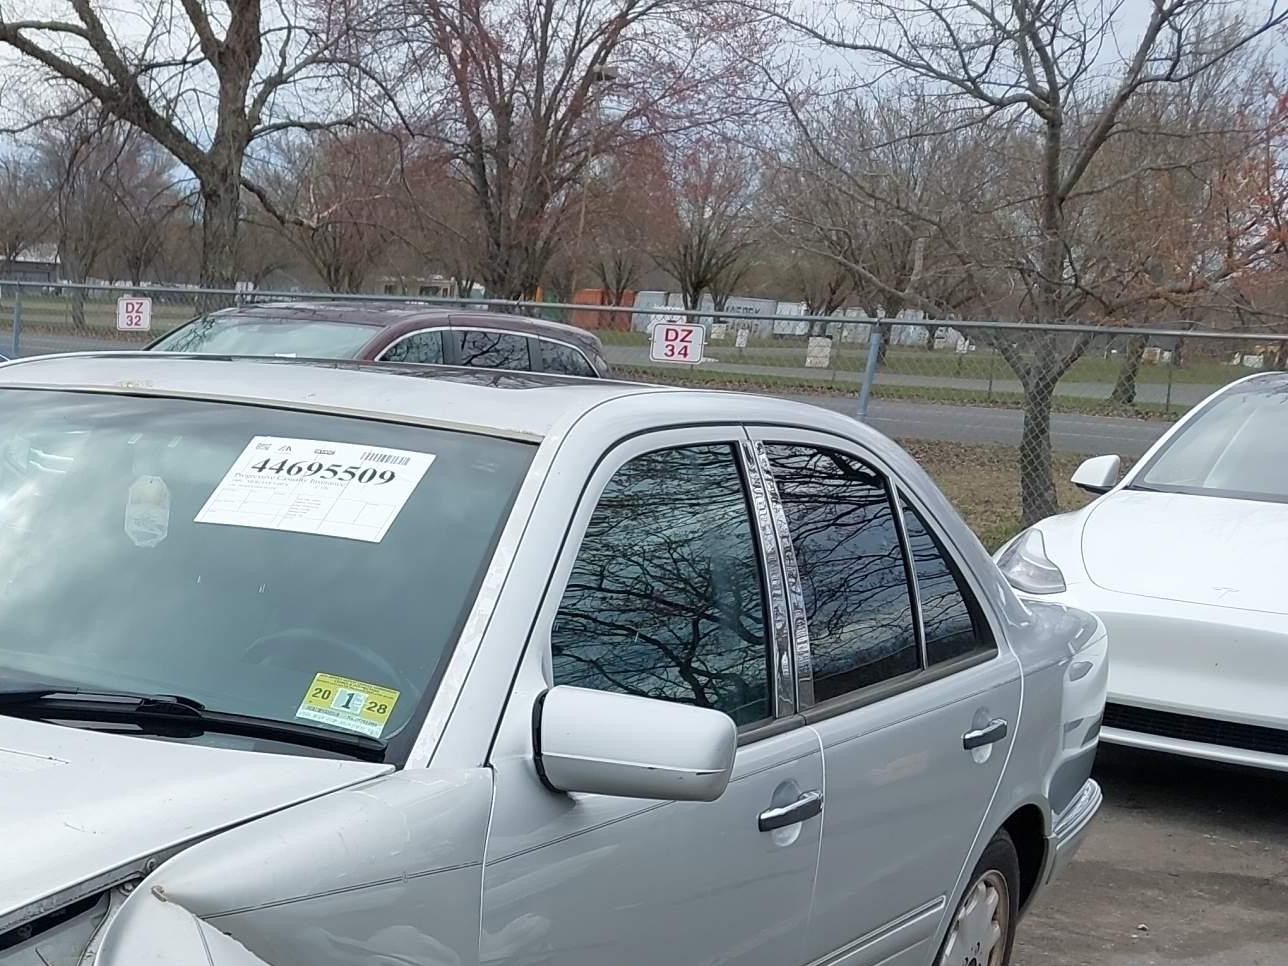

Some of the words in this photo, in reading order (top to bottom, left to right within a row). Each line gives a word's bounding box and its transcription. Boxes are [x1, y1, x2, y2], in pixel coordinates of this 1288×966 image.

[125, 302, 144, 314] DZ
[126, 314, 142, 327] 32
[664, 327, 693, 343] DZ
[663, 343, 689, 359] 34
[251, 457, 396, 486] 44695509
[312, 687, 331, 700] 20
[341, 692, 356, 710] 1
[365, 701, 388, 714] 28
